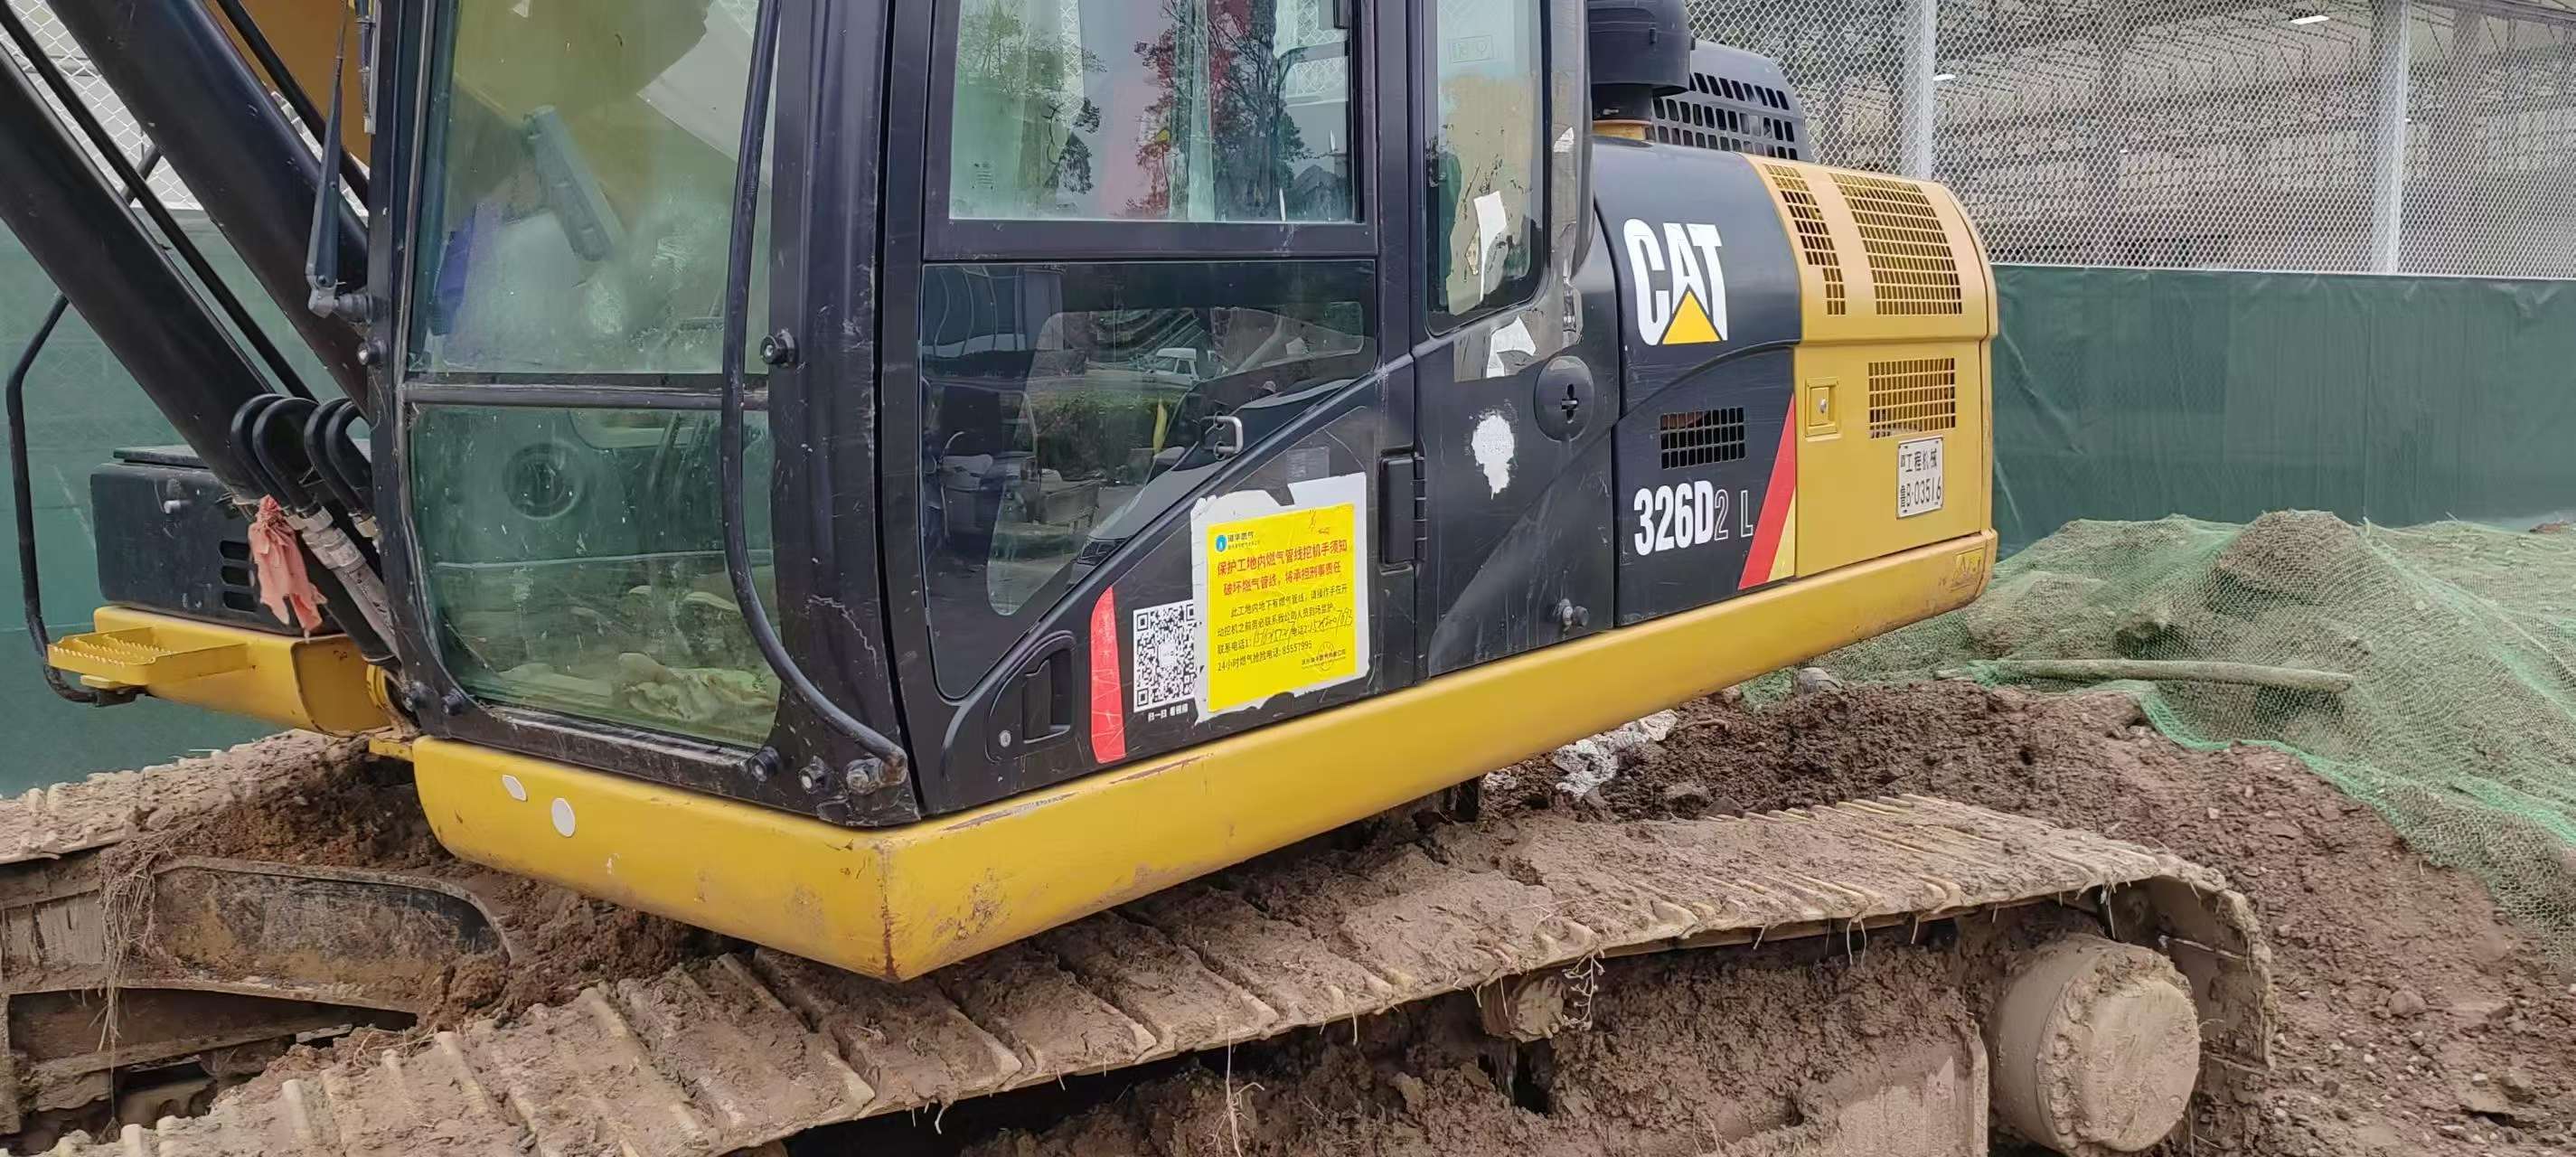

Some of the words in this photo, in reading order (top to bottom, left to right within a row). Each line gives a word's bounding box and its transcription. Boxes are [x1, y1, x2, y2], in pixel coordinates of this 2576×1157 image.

[1623, 218, 1728, 345] CAT
[1740, 489, 1753, 538] L
[1217, 540, 1348, 576] 保护工地内燃气管线挖机手须知
